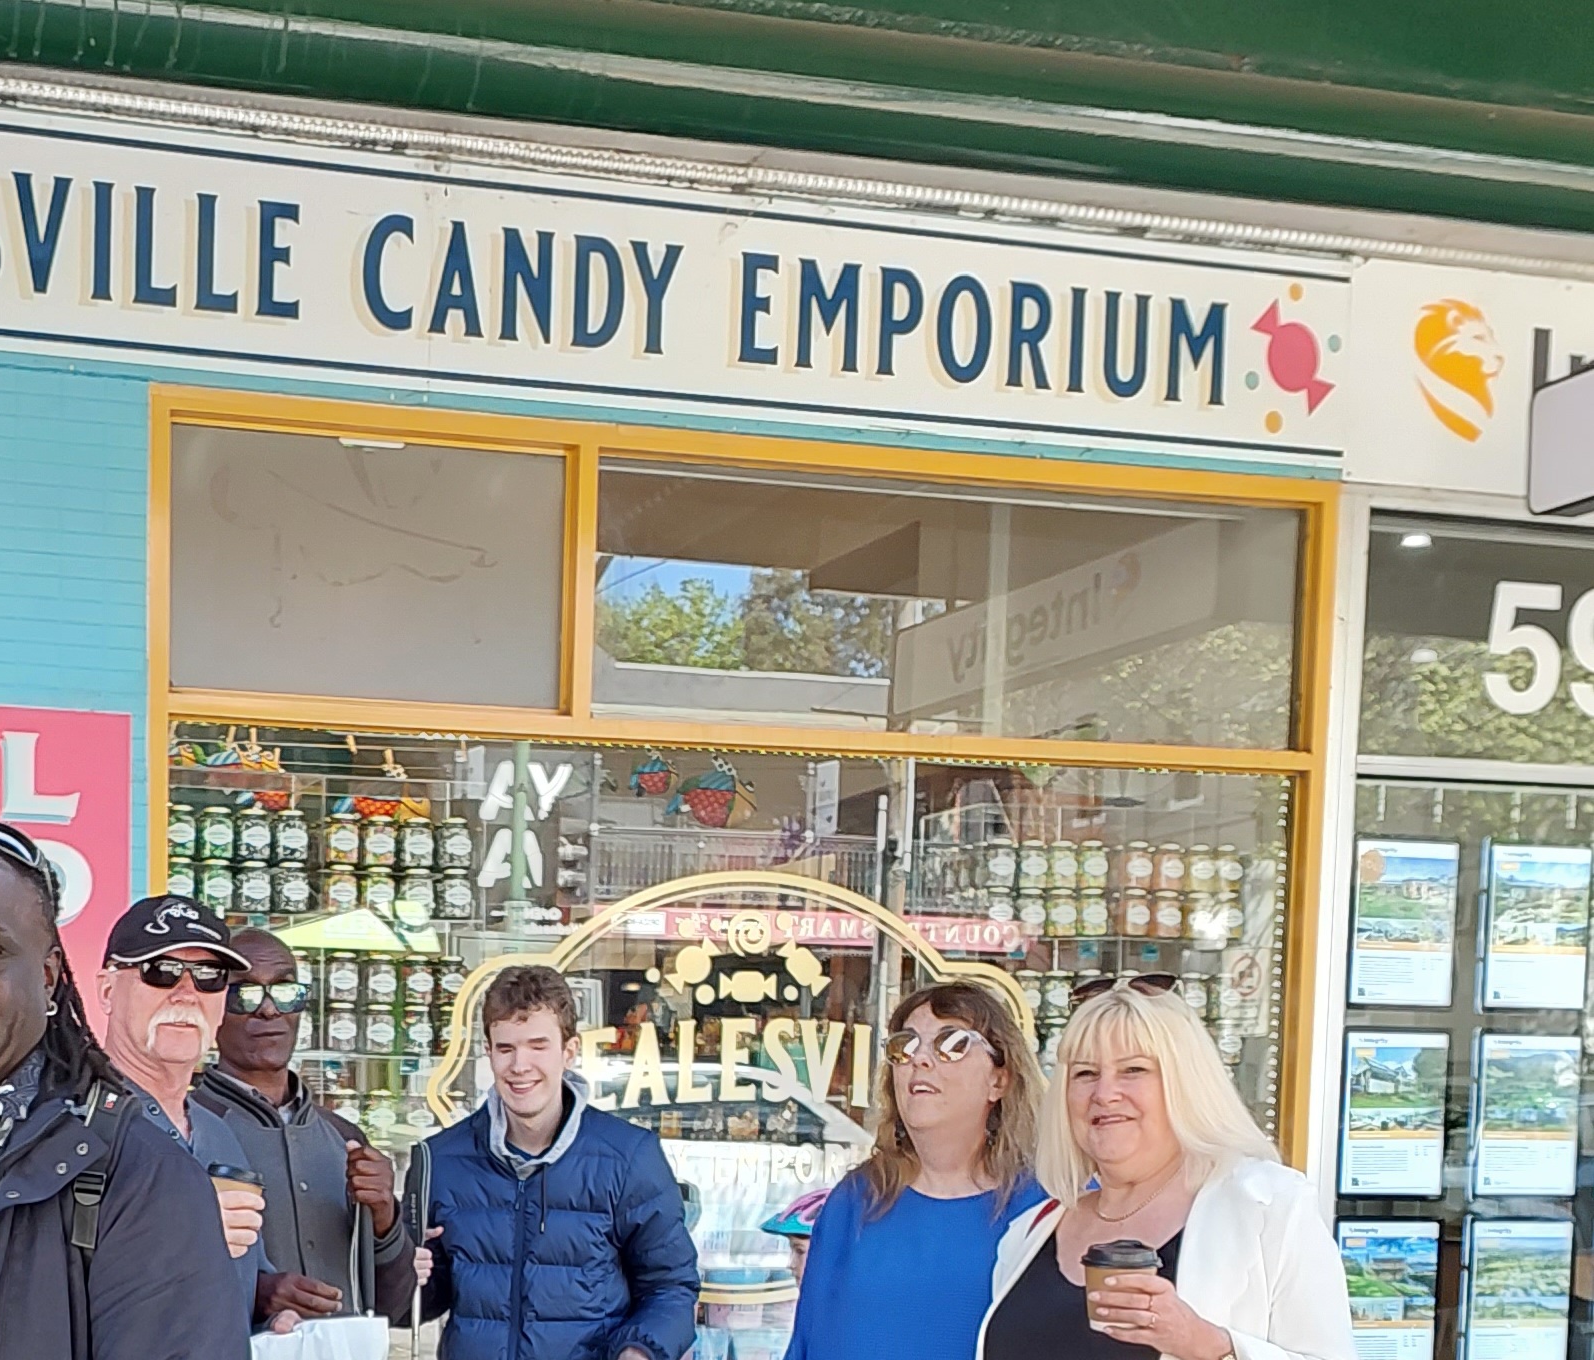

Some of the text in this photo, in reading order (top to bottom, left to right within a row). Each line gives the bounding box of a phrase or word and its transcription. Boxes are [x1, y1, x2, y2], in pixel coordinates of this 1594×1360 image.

[361, 212, 684, 355] CANDY
[739, 252, 1228, 407] EMPORIUM
[580, 1016, 873, 1111] EALESVI
